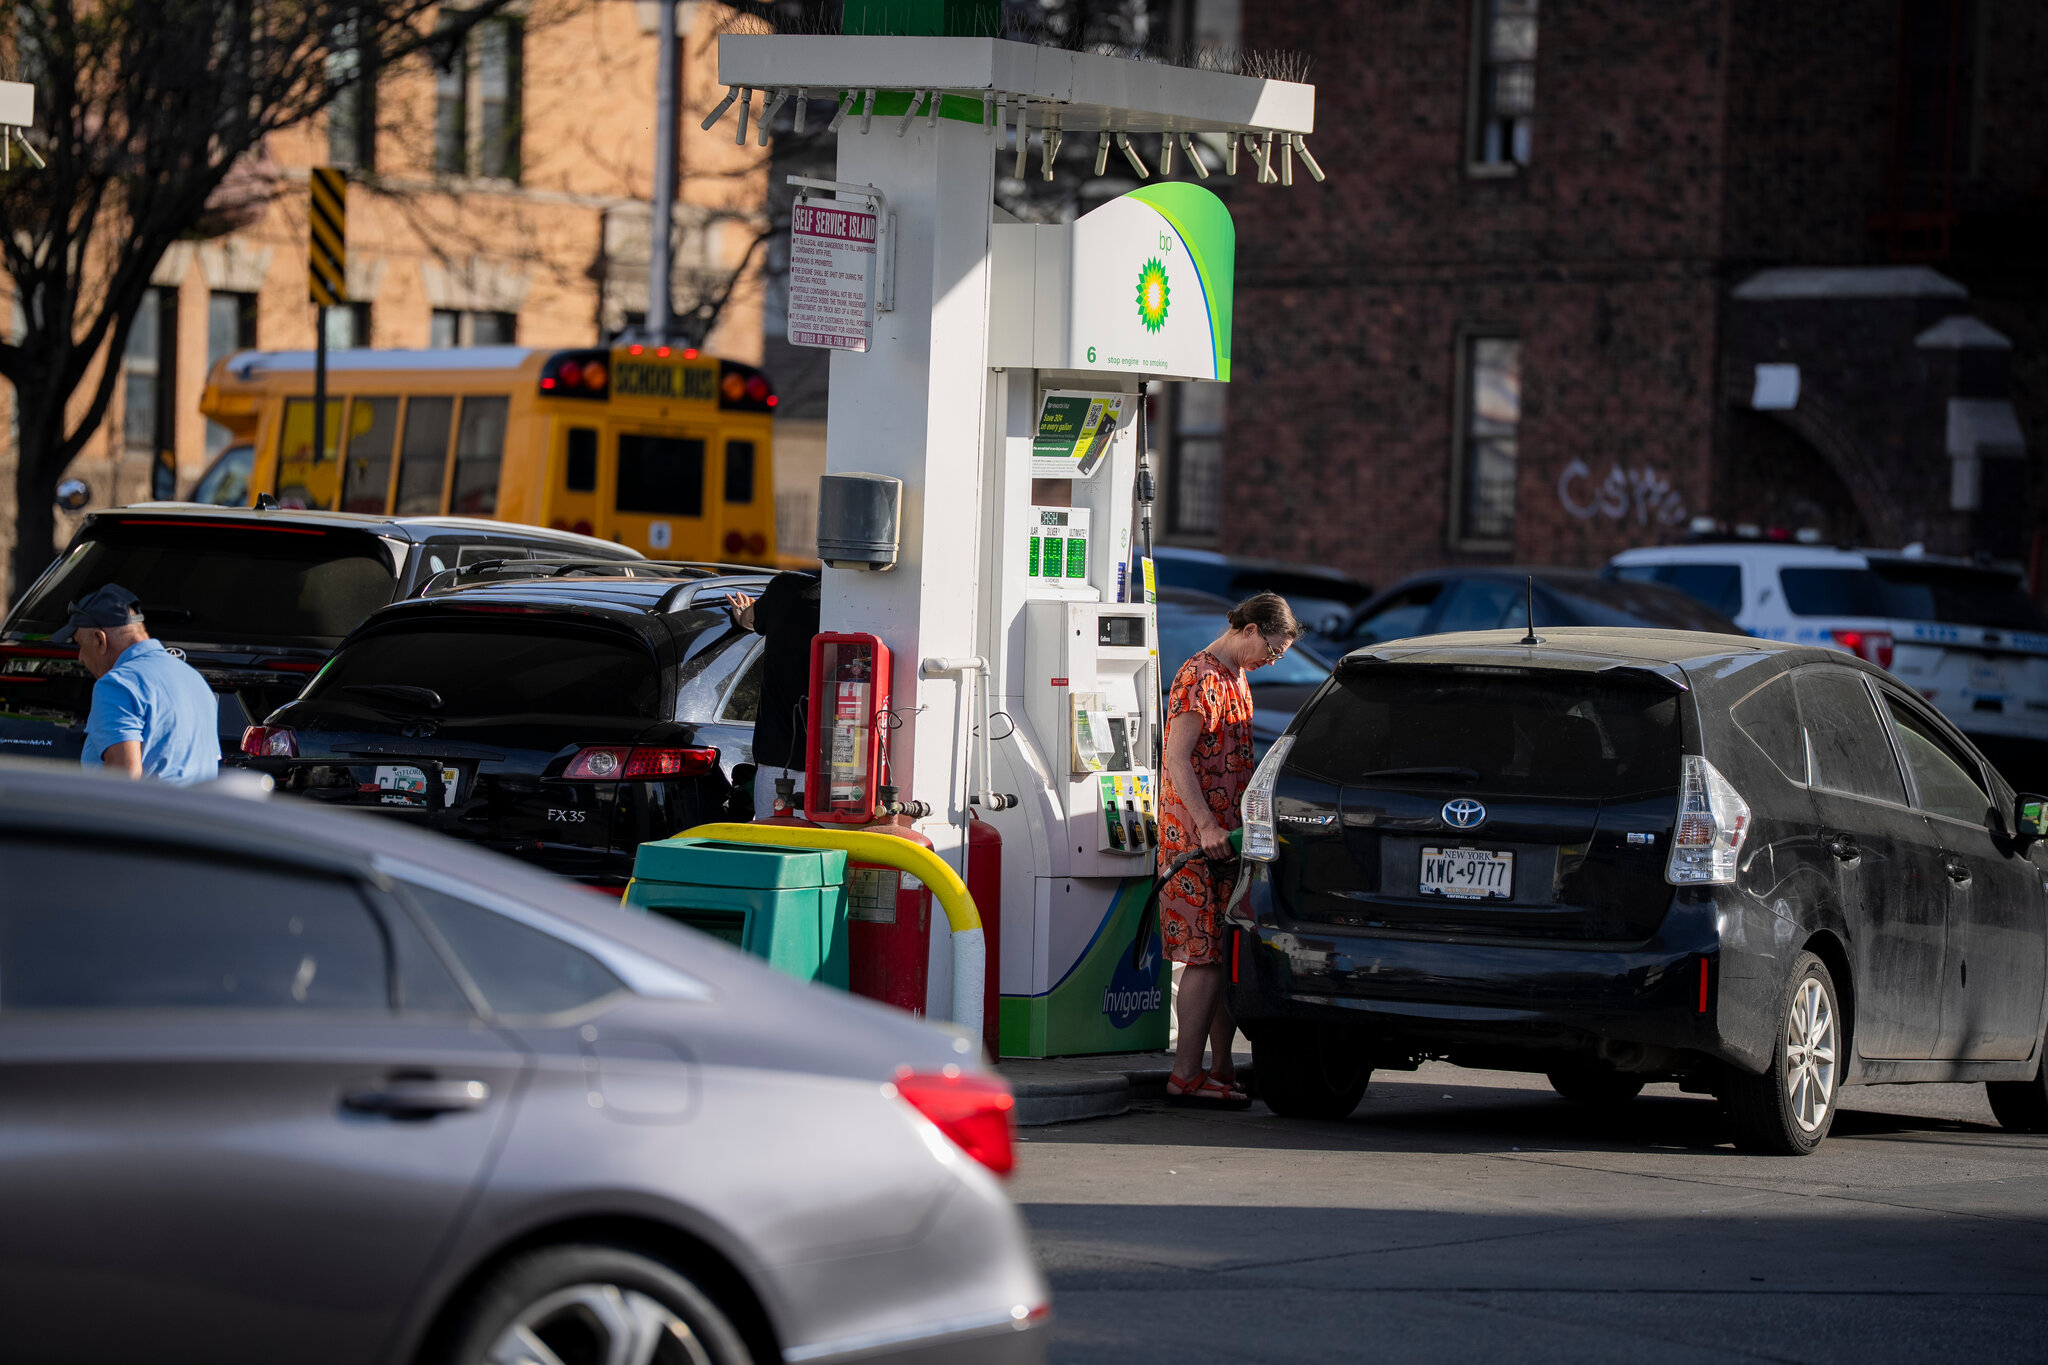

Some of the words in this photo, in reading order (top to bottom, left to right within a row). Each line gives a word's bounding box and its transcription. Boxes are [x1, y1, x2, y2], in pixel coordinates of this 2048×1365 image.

[795, 208, 813, 232] SELF
[816, 210, 846, 236] SERVICE
[849, 215, 875, 240] ISLAND
[825, 241, 844, 250] DANGEROUS
[1160, 230, 1172, 256] bp
[795, 246, 814, 254] CONTAINERS
[810, 287, 829, 296] CONTAINERS
[825, 316, 844, 325] CUSTOMERS
[801, 332, 816, 343] ORDER
[824, 334, 833, 344] THE
[834, 335, 844, 345] FIRE
[1087, 346, 1096, 363] 6
[1108, 357, 1120, 365] stop
[1121, 358, 1139, 366] engine
[1150, 358, 1168, 369] smoking
[617, 362, 676, 398] SCHOOL
[684, 366, 712, 399] BUS
[1043, 414, 1054, 422] Save
[1047, 423, 1058, 432] every
[1279, 815, 1321, 824] PRIUS
[1444, 850, 1466, 859] NEW
[1467, 851, 1491, 861] YORK
[1426, 859, 1455, 883] KWC
[1467, 861, 1506, 886] 9777
[1102, 986, 1161, 1018] Invigorate
